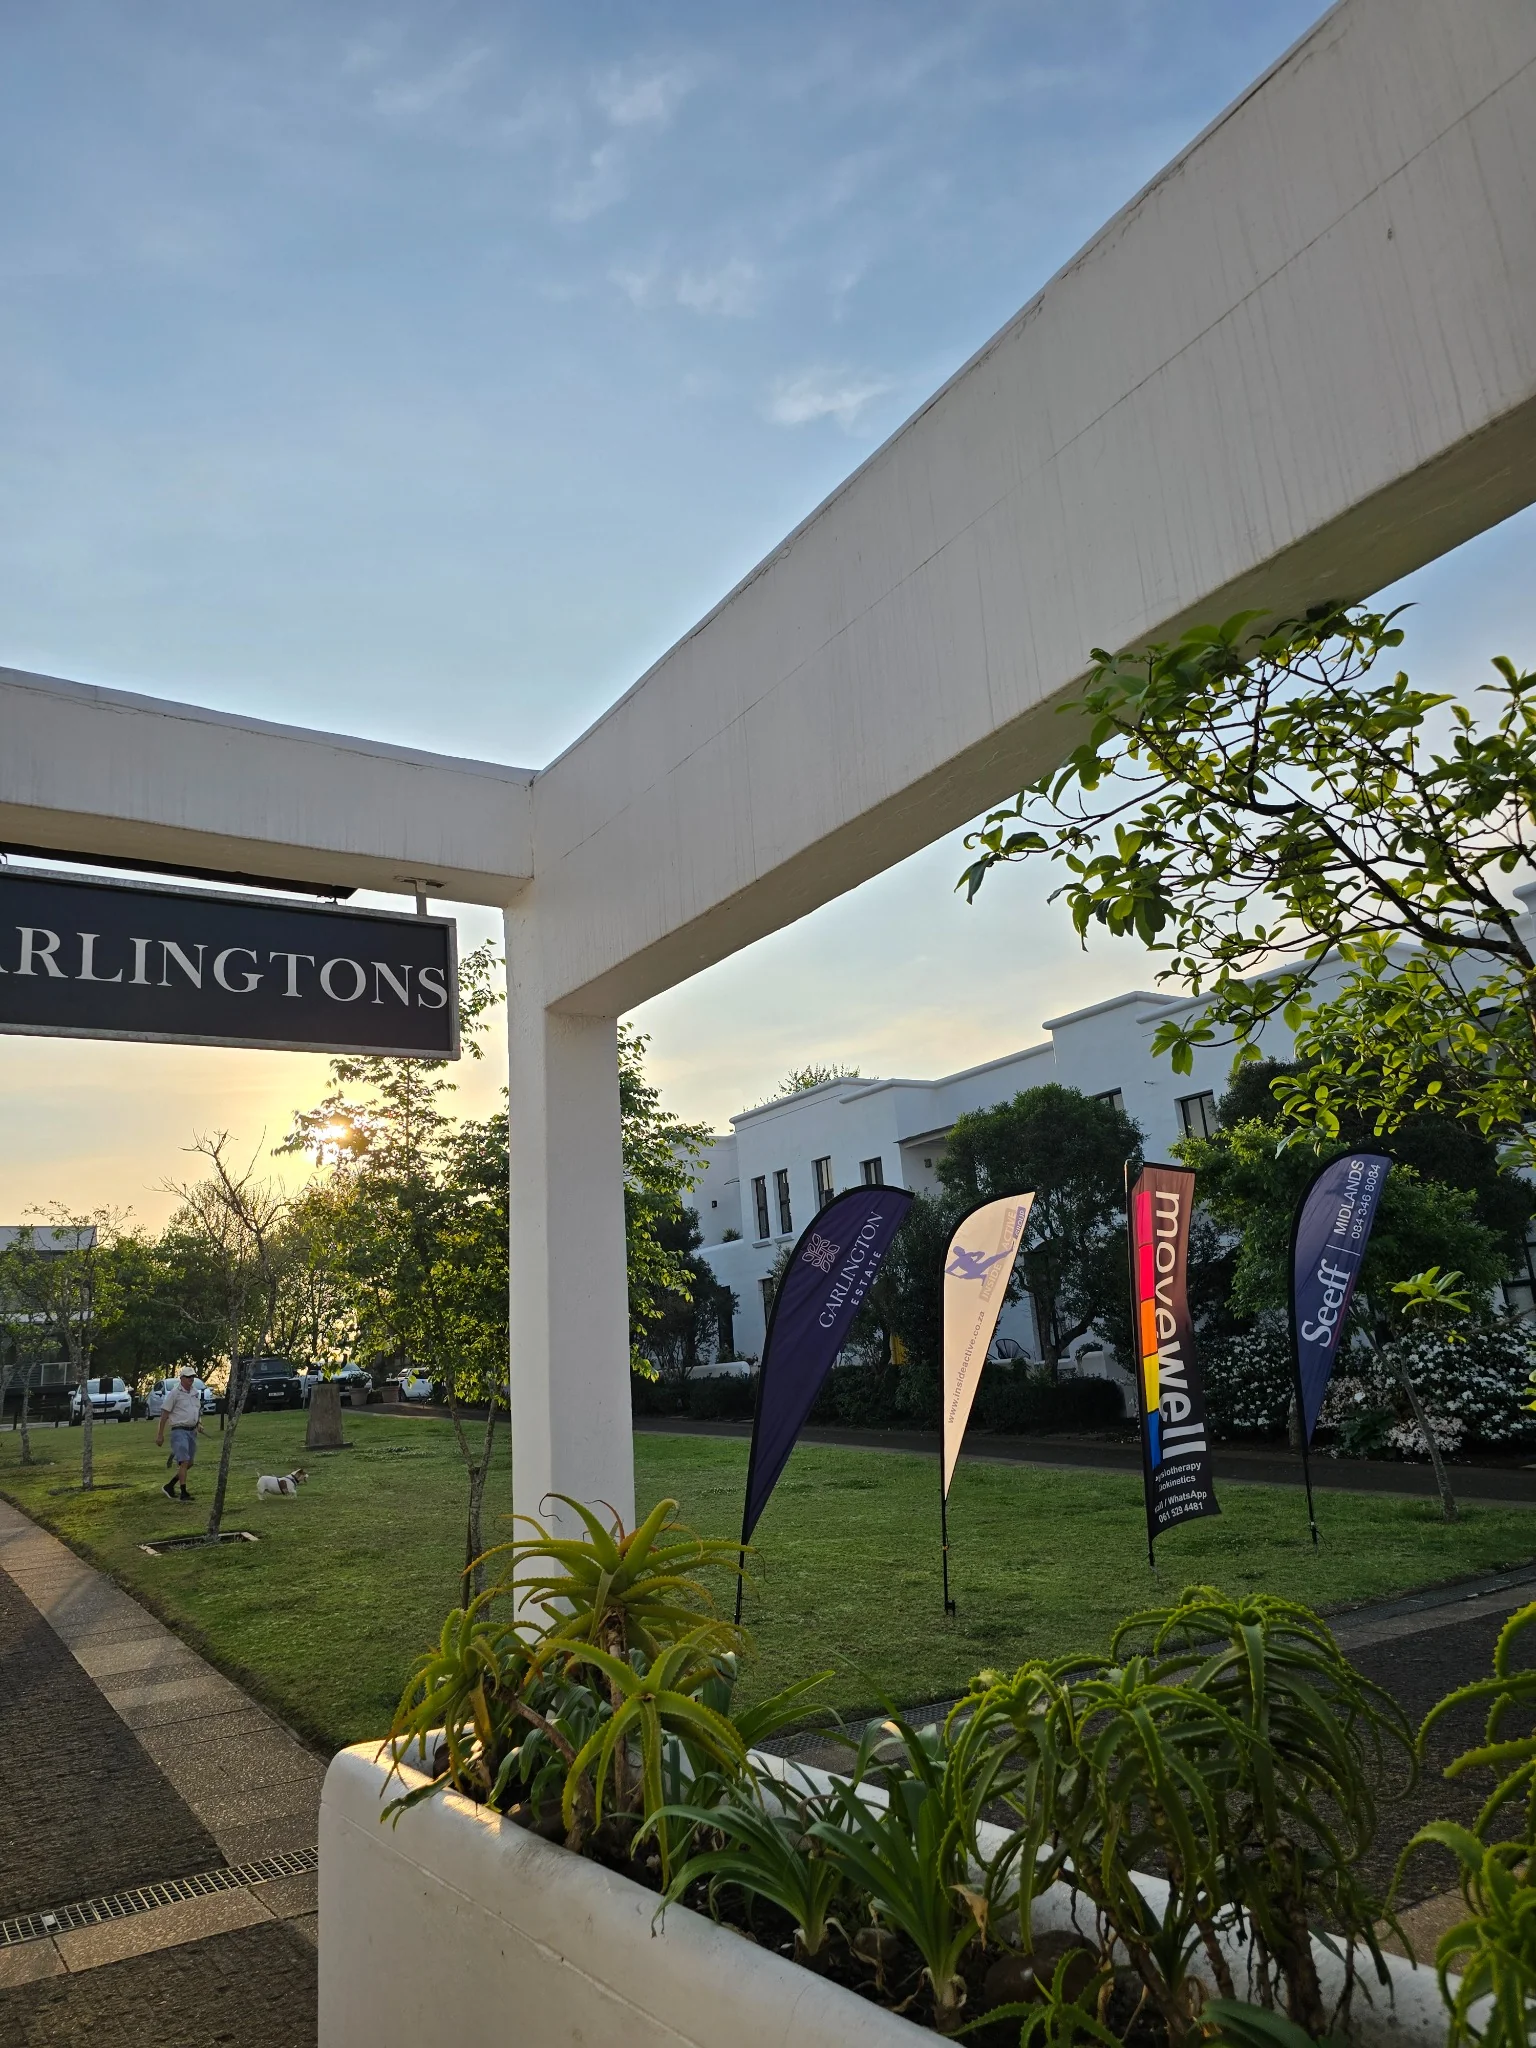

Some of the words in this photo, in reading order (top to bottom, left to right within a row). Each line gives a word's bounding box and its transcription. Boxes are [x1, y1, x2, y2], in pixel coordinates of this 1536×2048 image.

[0, 926, 449, 1010] RLINGTONS
[1333, 1160, 1365, 1236] MIDLANDS
[1358, 1194, 1372, 1216] 346
[1364, 1164, 1381, 1192] 8084
[982, 1263, 1002, 1299] INSIDE
[1002, 1210, 1016, 1250] ACTIVE
[1351, 1218, 1365, 1239] 084
[819, 1211, 884, 1328] GARLINGTON
[850, 1250, 882, 1306] ESTATE
[1301, 1257, 1351, 1348] Seeff
[1155, 1190, 1207, 1460] movewell
[947, 1310, 985, 1424] www.insideactive.co.za
[1158, 1510, 1171, 1524] 061
[1184, 1501, 1204, 1512] 4481
[1168, 1490, 1208, 1505] WhatsApp
